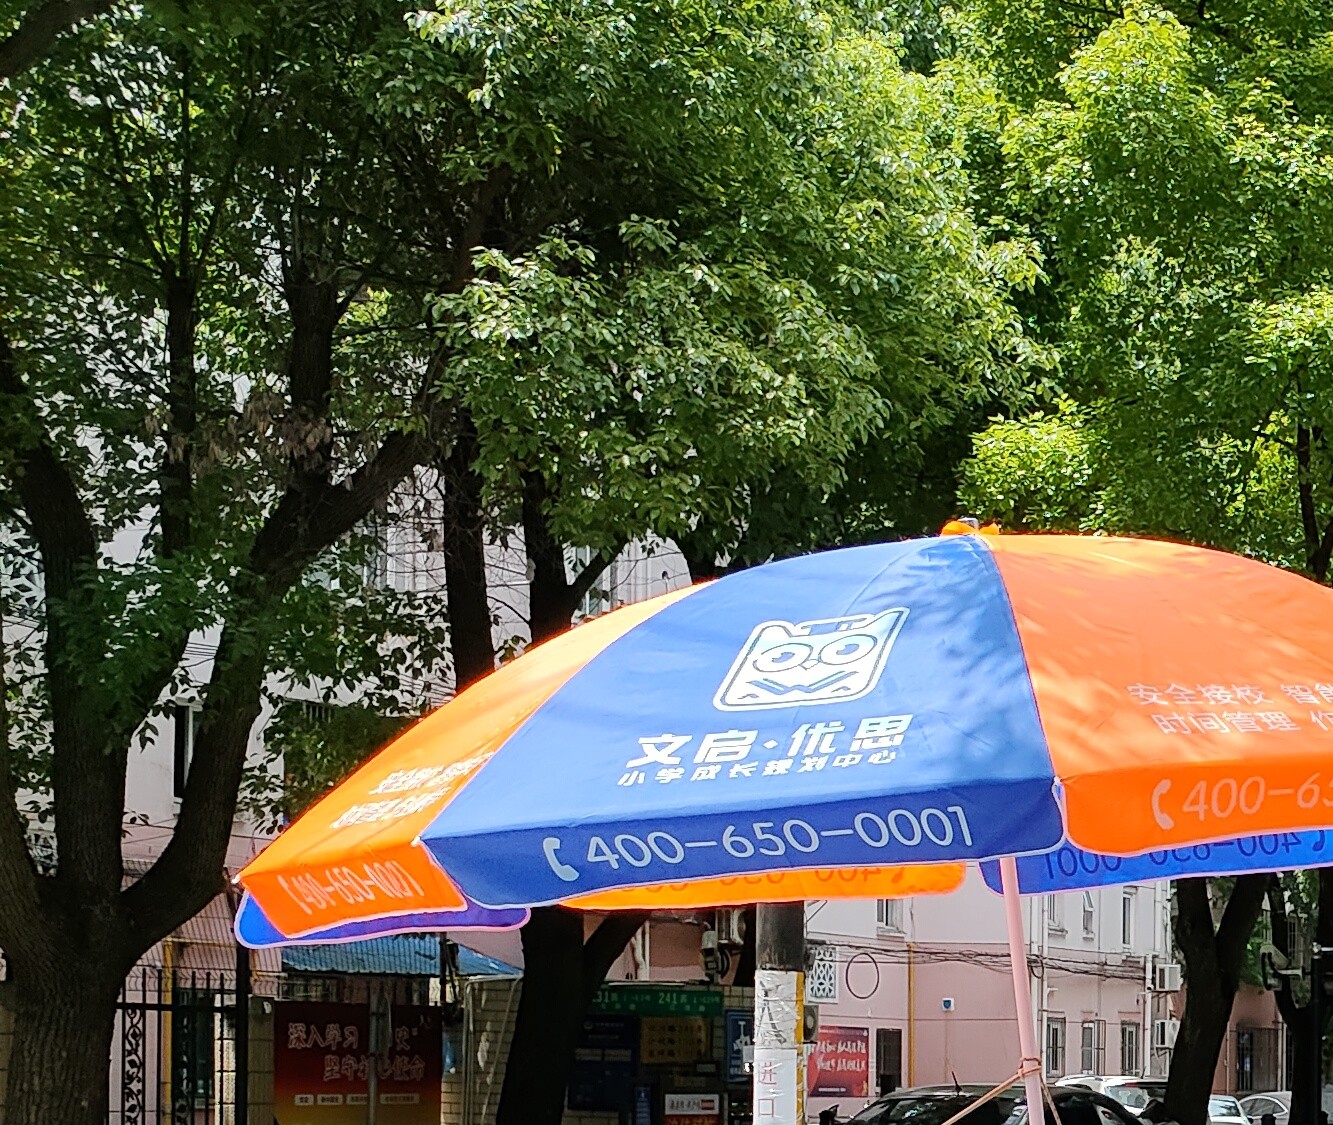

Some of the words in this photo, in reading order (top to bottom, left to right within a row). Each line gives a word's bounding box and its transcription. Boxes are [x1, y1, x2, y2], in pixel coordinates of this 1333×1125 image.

[626, 714, 913, 768] 文启·优思
[1150, 711, 1300, 734] 时间管理
[617, 749, 898, 787] 小学成长规划中心
[587, 806, 973, 869] 400-650-0001
